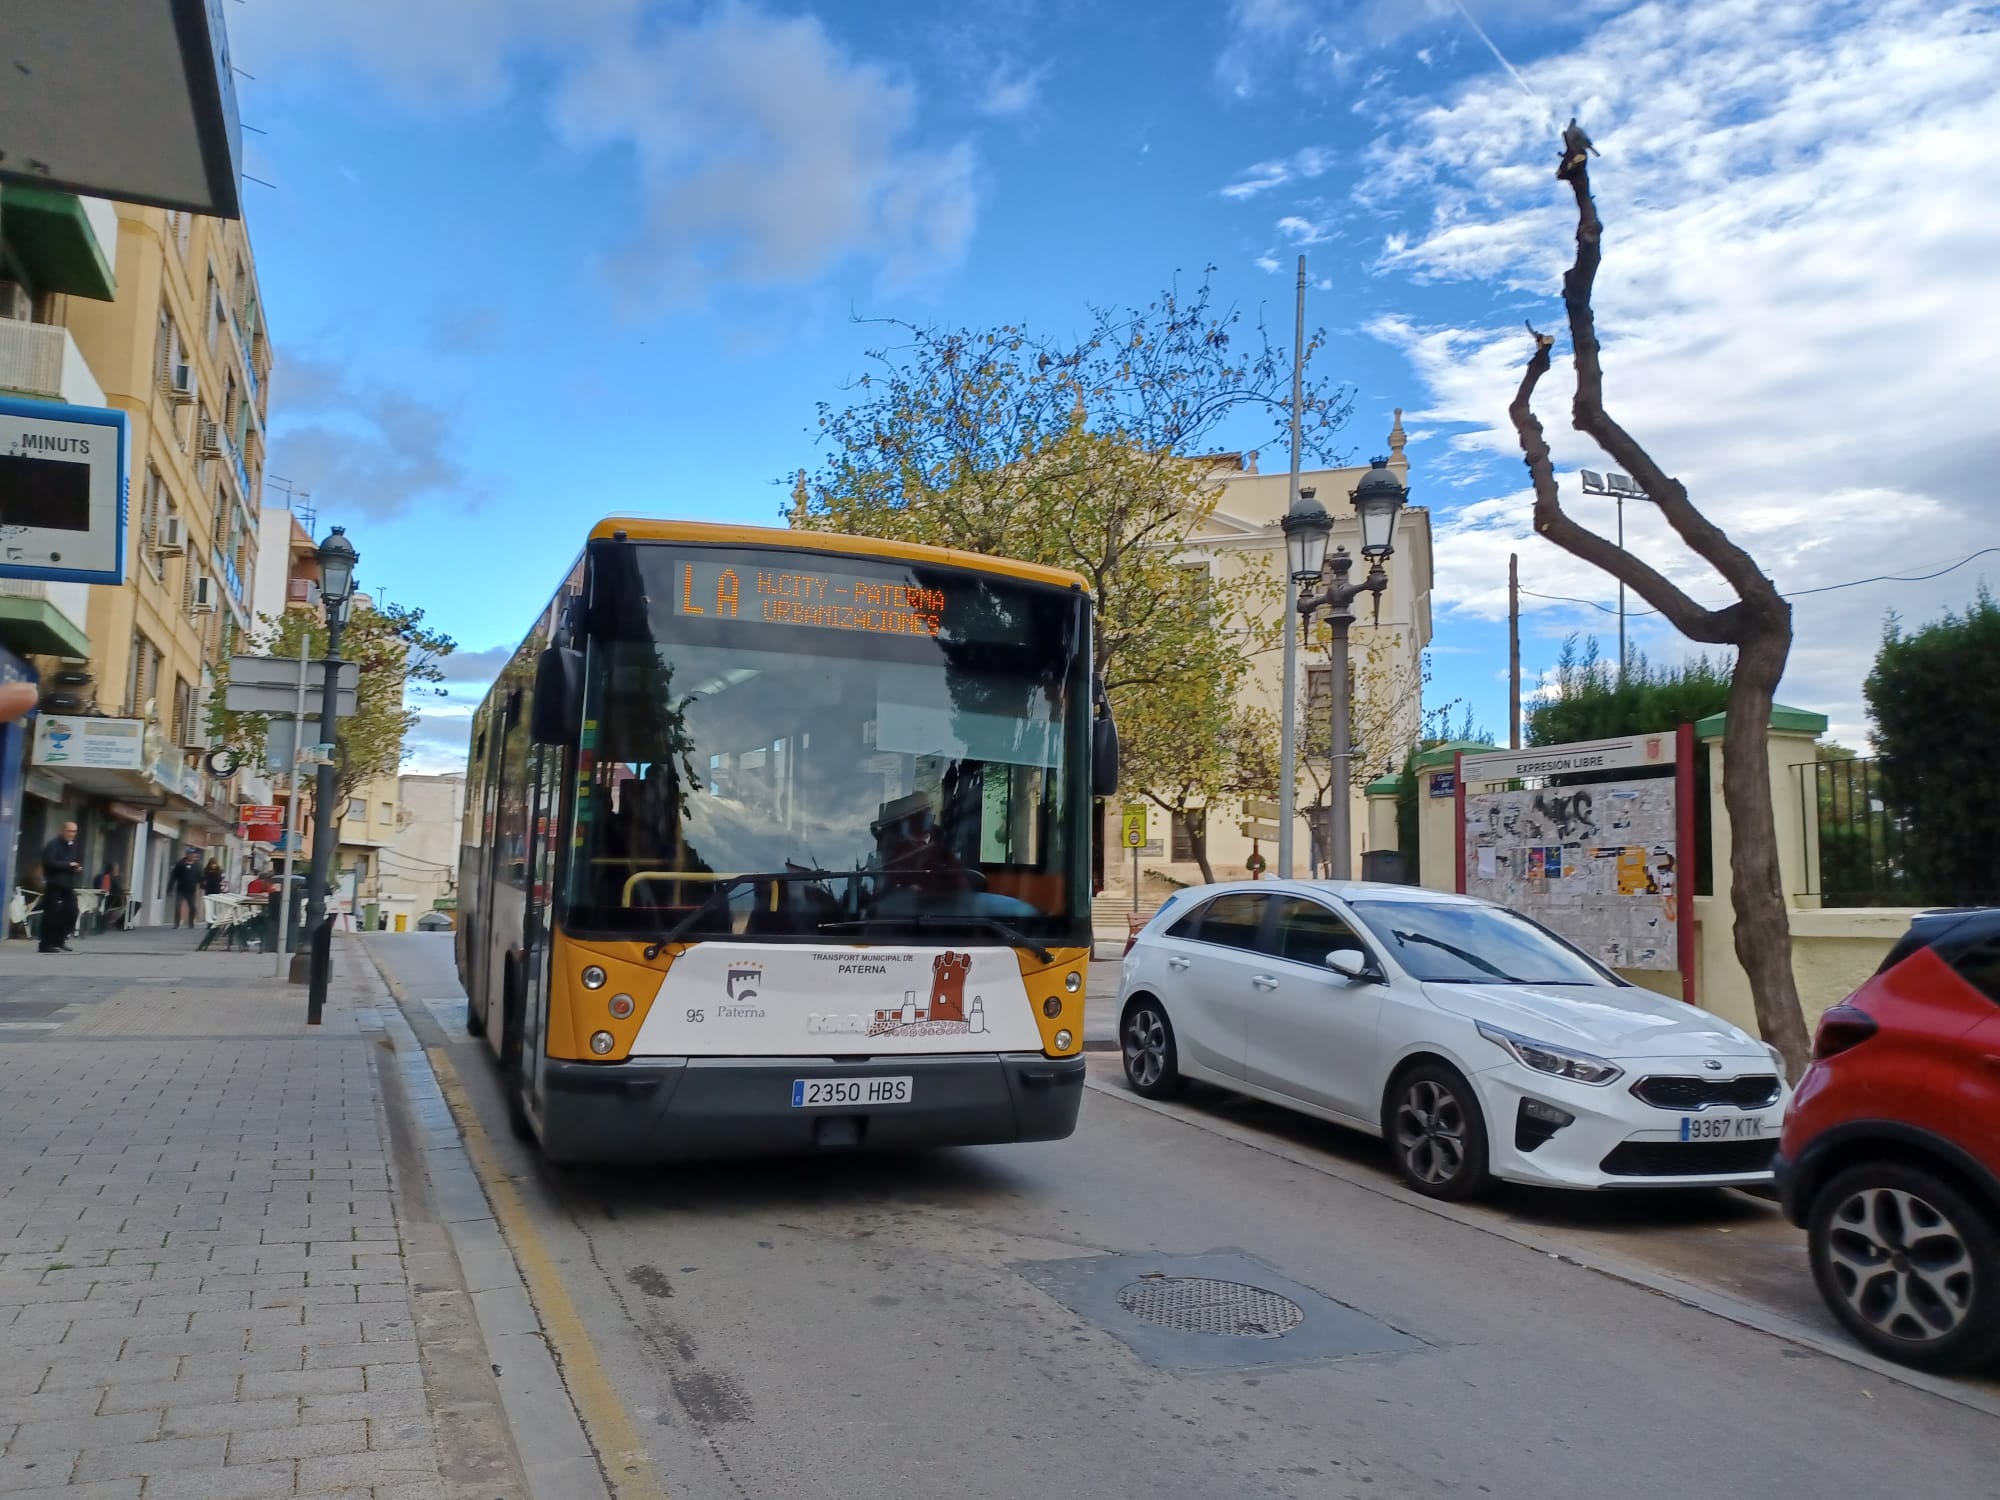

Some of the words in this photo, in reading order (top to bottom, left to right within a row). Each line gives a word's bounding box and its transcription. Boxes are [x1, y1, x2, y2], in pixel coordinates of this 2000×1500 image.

[21, 433, 90, 454] MINUTS
[855, 583, 946, 611] PATERNA
[764, 600, 940, 636] URBANIZACIONES
[1573, 755, 1604, 768] LIBRE
[812, 953, 860, 962] TRANSPORT
[861, 954, 901, 962] MUNICIPAL
[902, 954, 913, 962] DE
[838, 964, 887, 975] PATERNA
[686, 1008, 705, 1023] 95
[717, 1005, 766, 1019] Paterna
[808, 1082, 861, 1103] 2350
[868, 1081, 907, 1101] HBS
[1692, 1119, 1732, 1138] 9367
[1735, 1118, 1762, 1137] KTK
